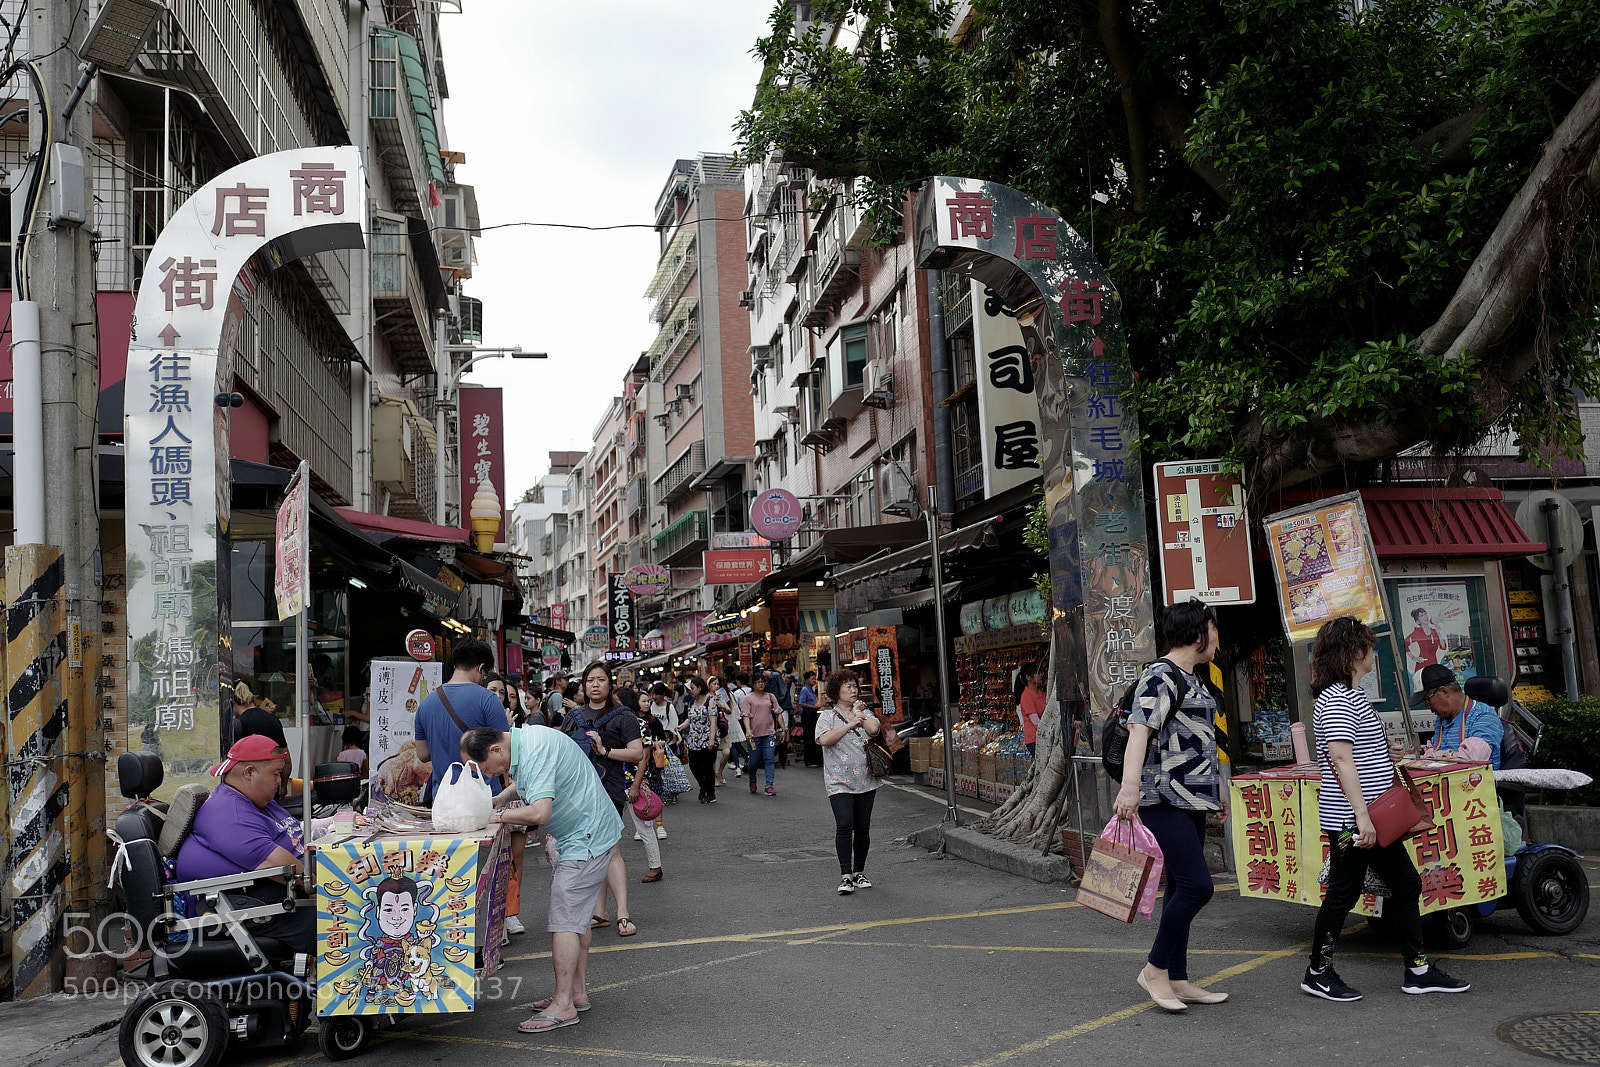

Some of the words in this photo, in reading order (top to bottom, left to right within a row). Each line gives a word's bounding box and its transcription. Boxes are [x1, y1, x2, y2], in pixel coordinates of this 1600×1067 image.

[159, 162, 347, 312] 商店街
[946, 191, 1103, 327] 商店街
[878, 648, 896, 715] 黑豬肉香腸
[346, 849, 450, 884] 刮刮樂
[1240, 784, 1281, 894] 刮刮樂
[1281, 808, 1298, 899] 公益彩券
[1413, 777, 1466, 907] 刮刮樂
[1463, 798, 1498, 899] 公益彩券
[326, 898, 349, 948] 馬上刮
[446, 895, 467, 943] 馬上中
